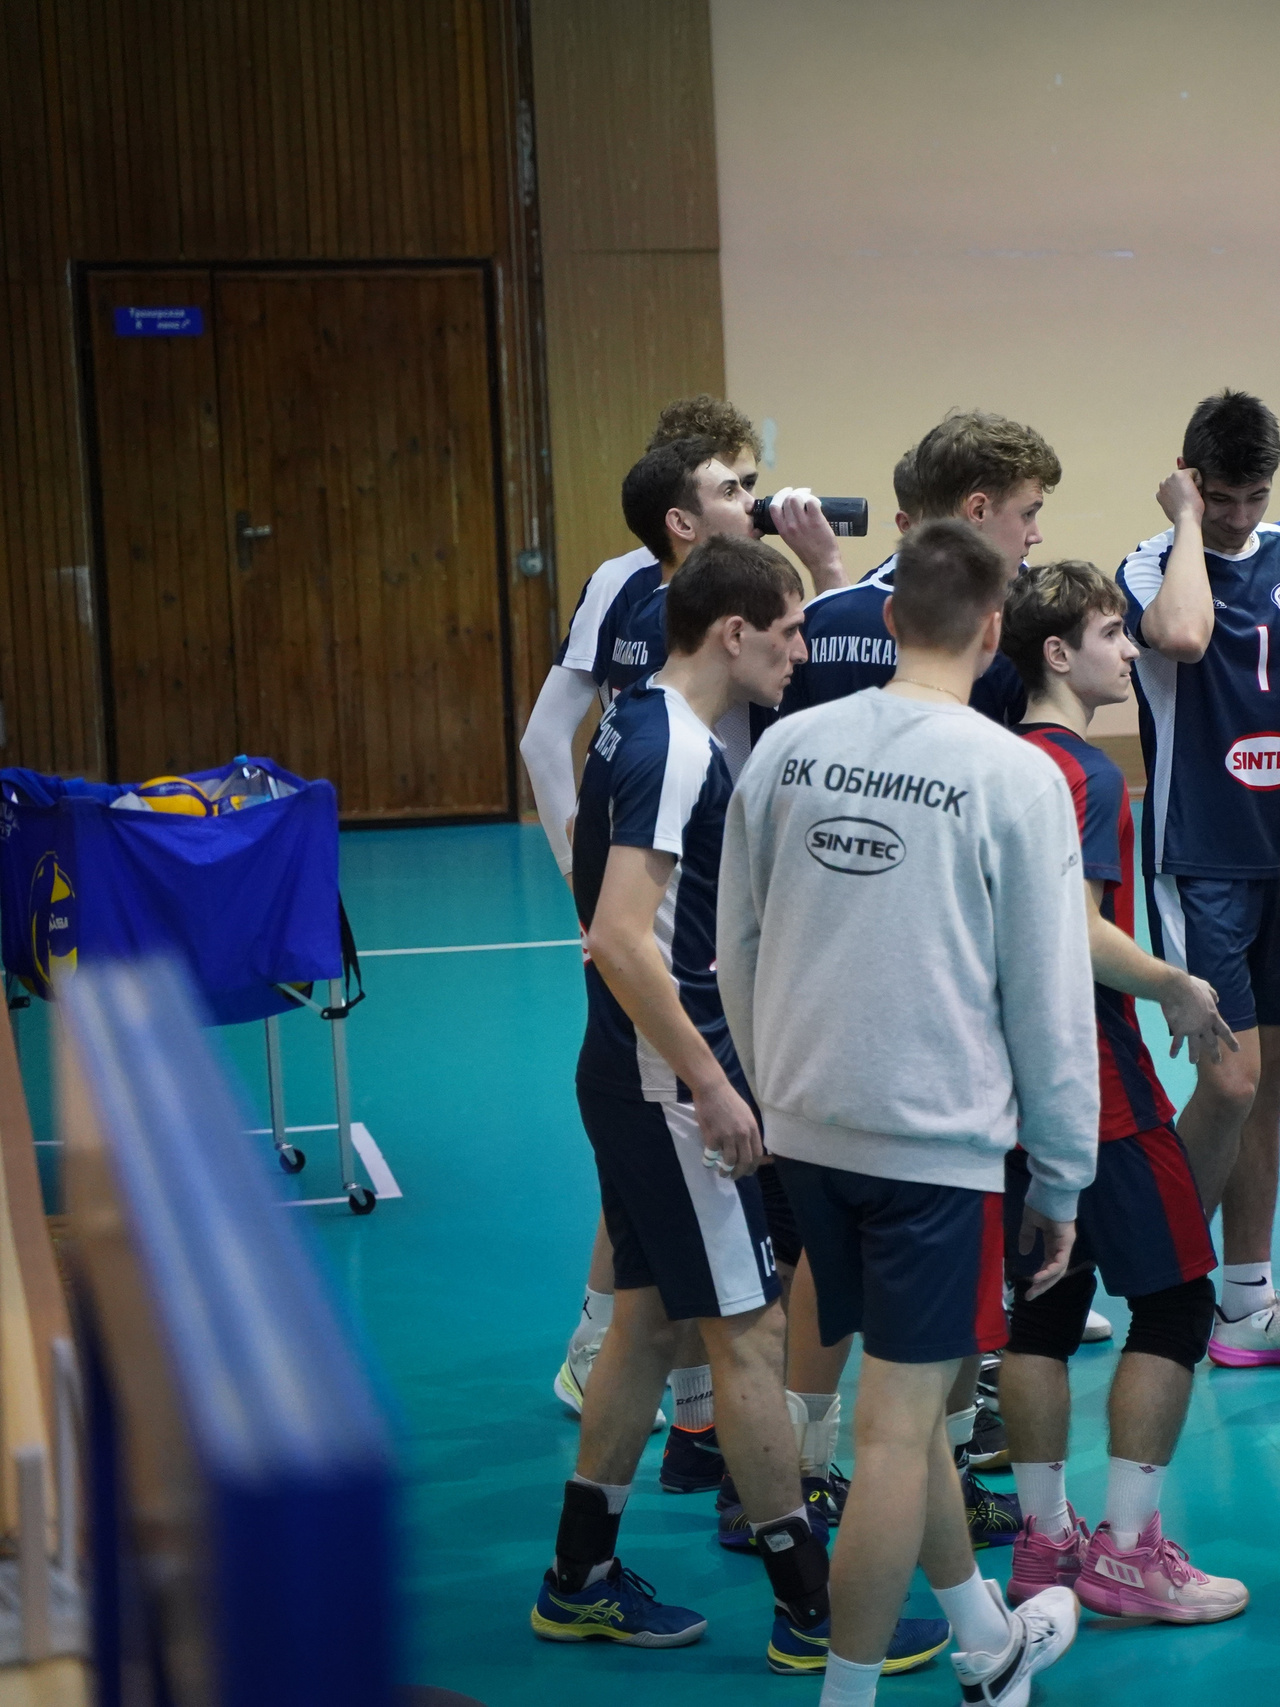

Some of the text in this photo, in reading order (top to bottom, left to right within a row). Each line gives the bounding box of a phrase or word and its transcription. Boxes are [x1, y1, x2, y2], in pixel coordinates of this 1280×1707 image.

[781, 758, 969, 818] ВК ОБНИНСК
[811, 831, 900, 861] SINTEC
